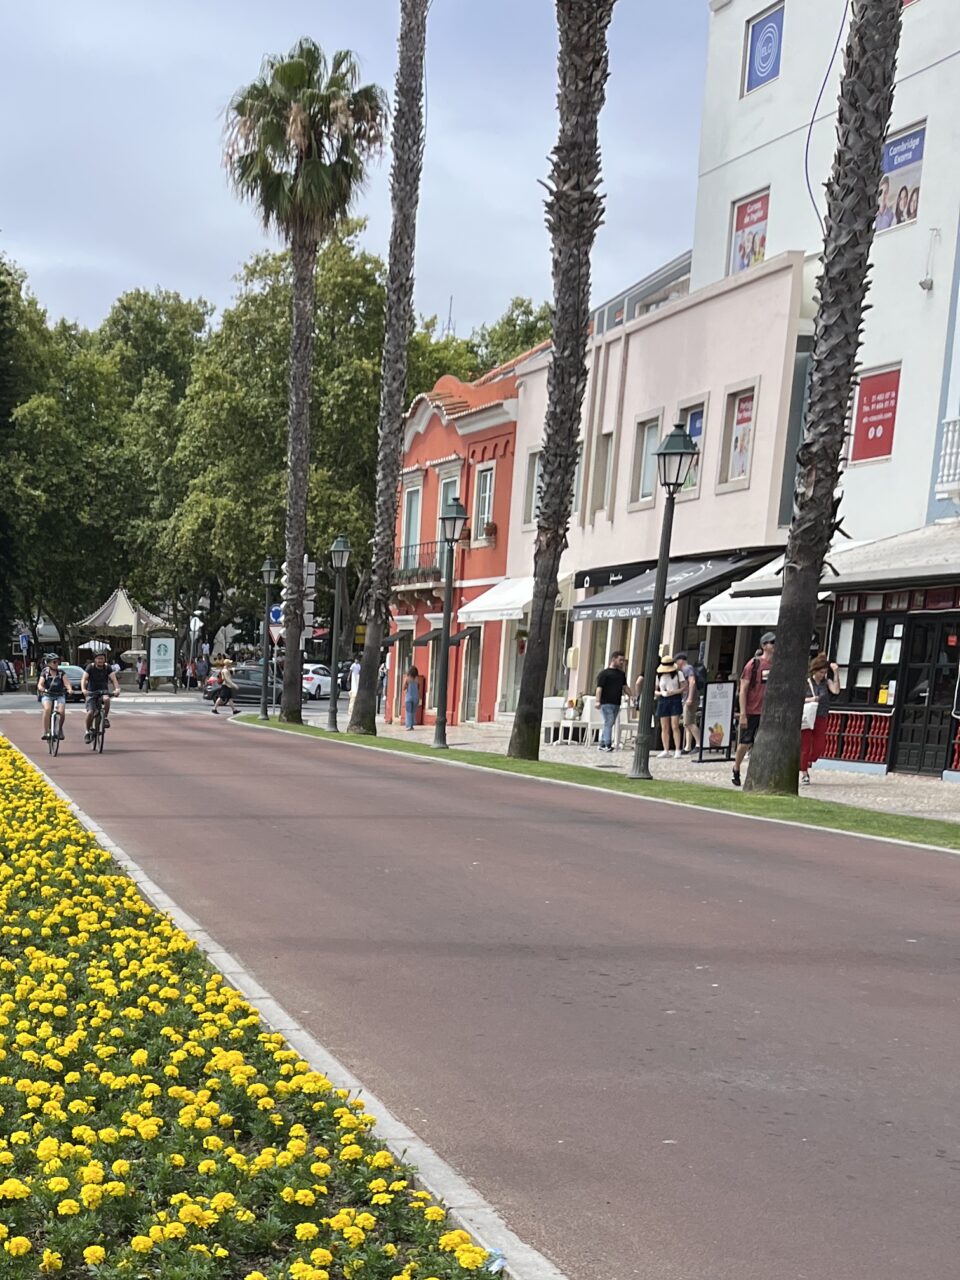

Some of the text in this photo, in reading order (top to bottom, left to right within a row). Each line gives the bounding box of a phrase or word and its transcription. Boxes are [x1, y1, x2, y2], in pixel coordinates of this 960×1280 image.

[762, 42, 772, 56] ELC
[889, 137, 920, 156] Cambridge
[894, 151, 912, 165] Exams
[603, 608, 617, 618] WORLD
[617, 608, 629, 617] NEEDS
